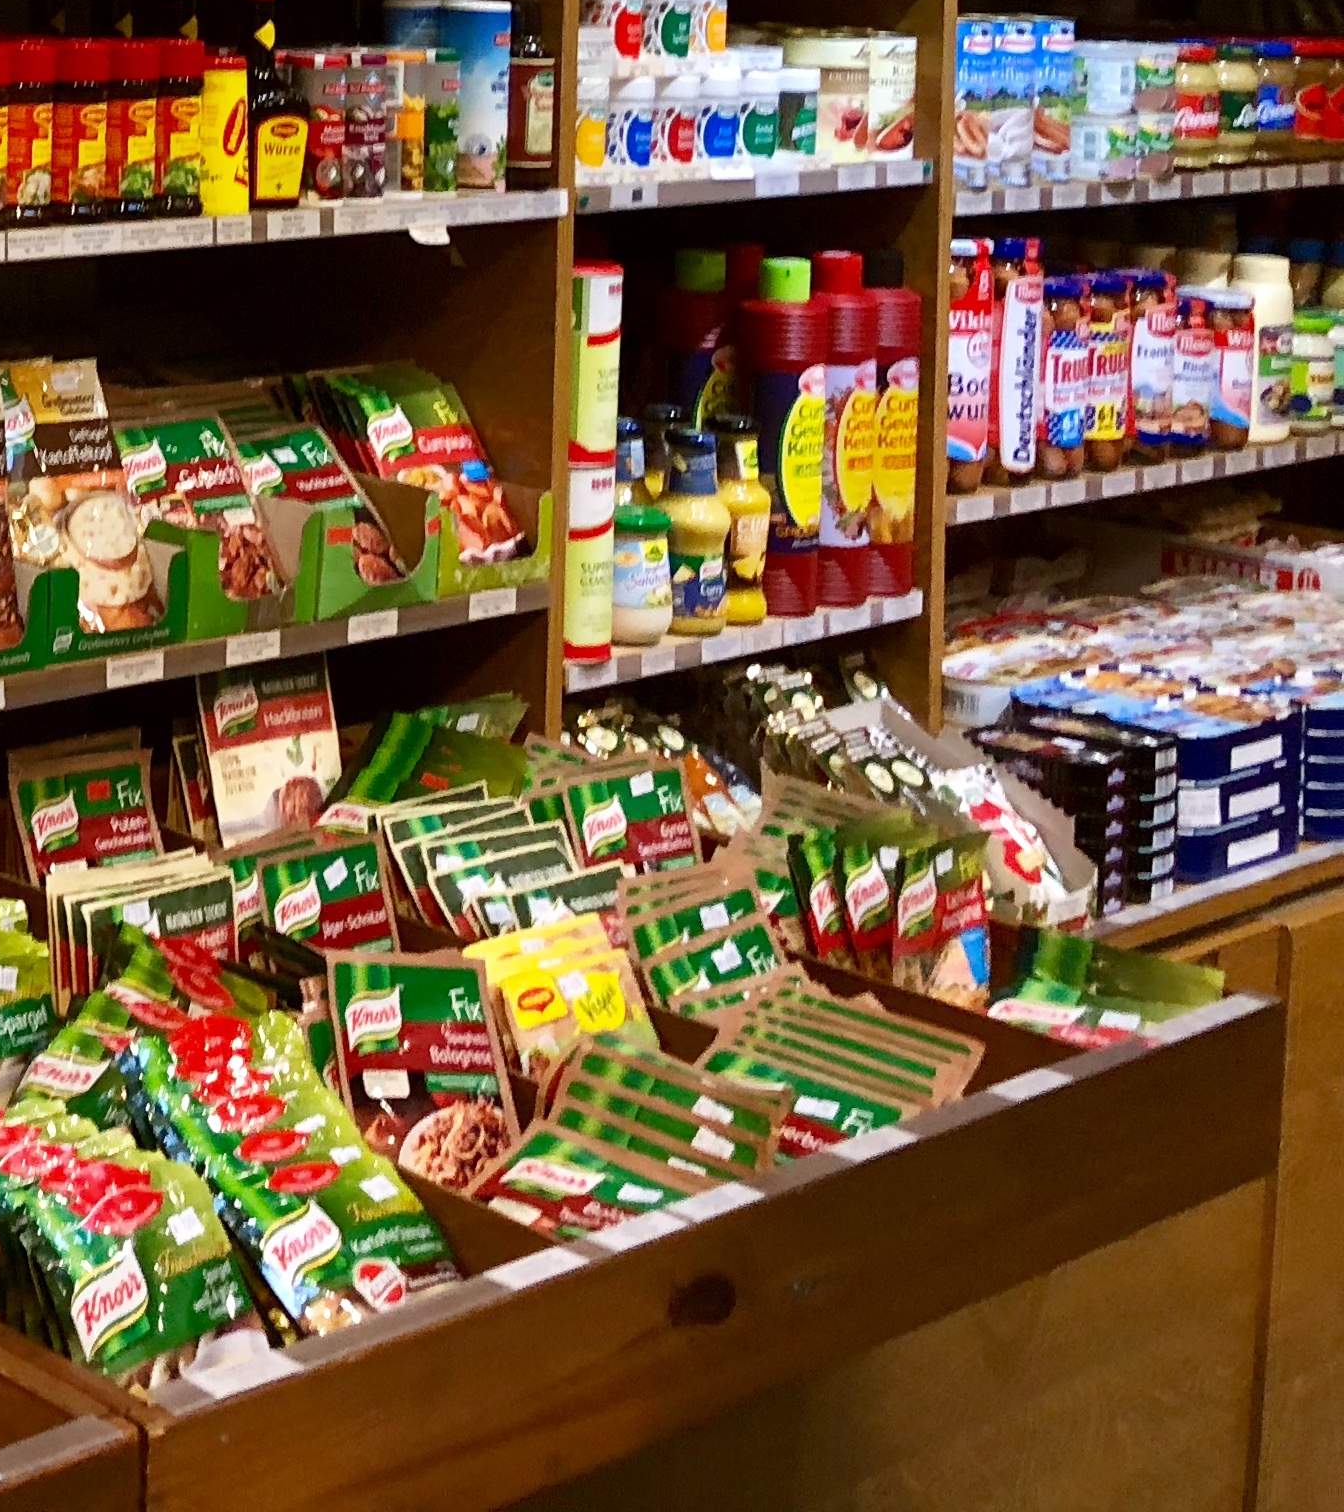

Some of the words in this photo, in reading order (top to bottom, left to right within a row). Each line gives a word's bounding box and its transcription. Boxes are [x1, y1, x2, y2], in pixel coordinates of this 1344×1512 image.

[115, 778, 145, 809] Fix
[657, 785, 683, 813] Fix
[353, 862, 381, 893] Fix
[347, 1001, 403, 1031] Knorr
[448, 988, 484, 1021] Fix
[269, 1210, 342, 1272] Knorr
